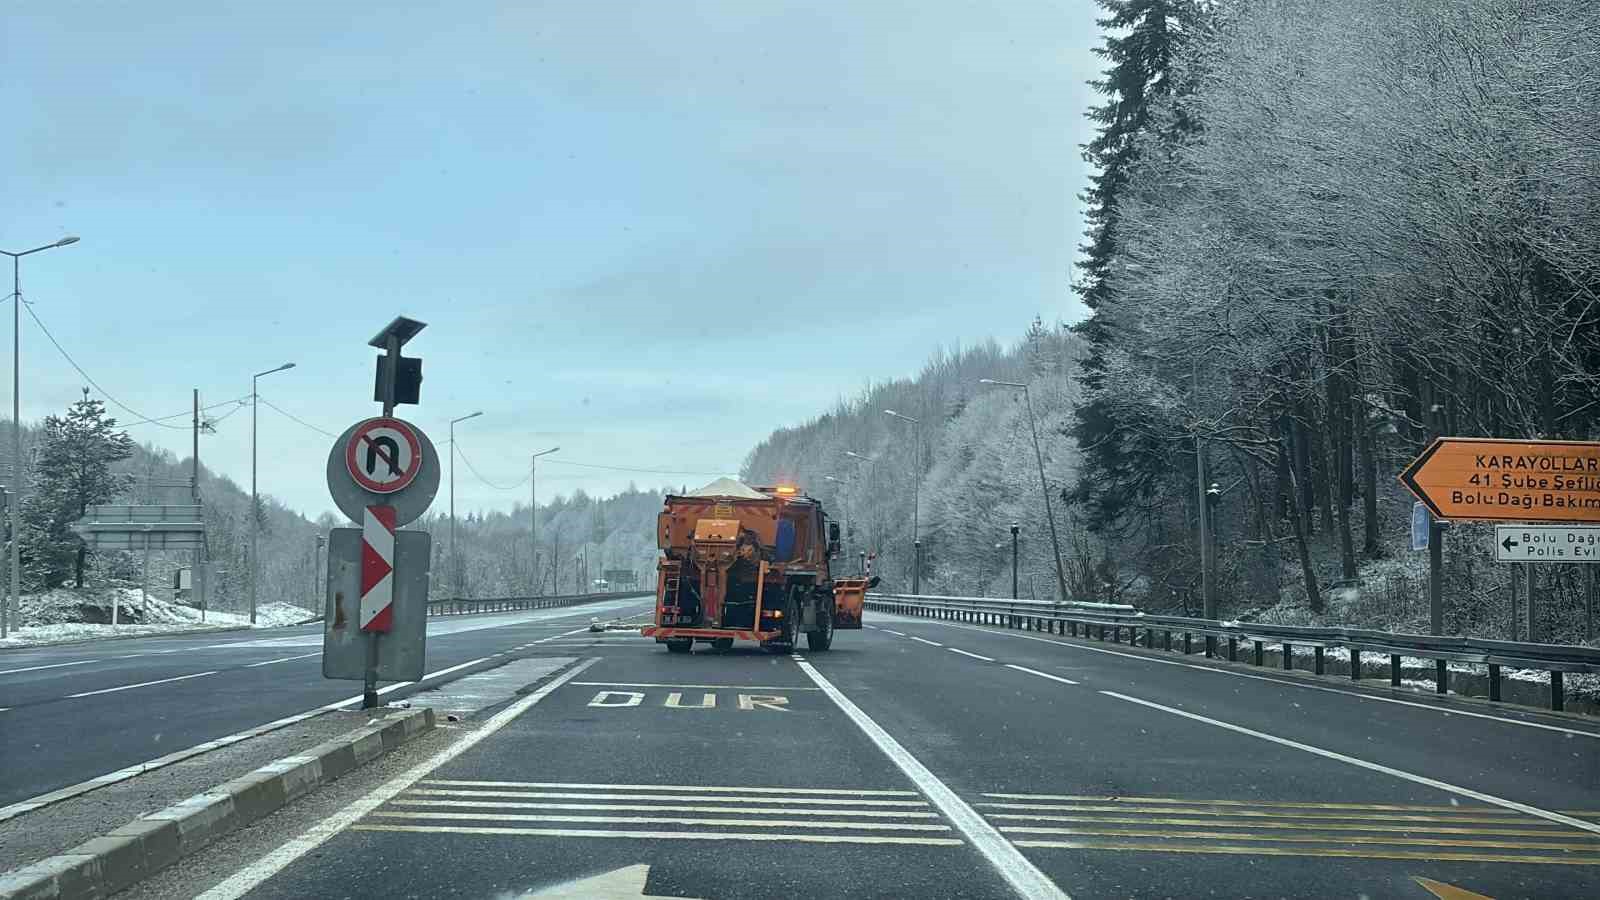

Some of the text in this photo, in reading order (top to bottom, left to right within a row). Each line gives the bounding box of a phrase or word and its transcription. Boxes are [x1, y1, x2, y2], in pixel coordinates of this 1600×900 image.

[1501, 473, 1548, 489] Şube
[1452, 490, 1493, 505] Bolu
[1498, 492, 1538, 510] Dağı
[1522, 532, 1556, 543] Bolu
[1527, 545, 1596, 556] Polis Evi
[587, 690, 792, 712] DUR
